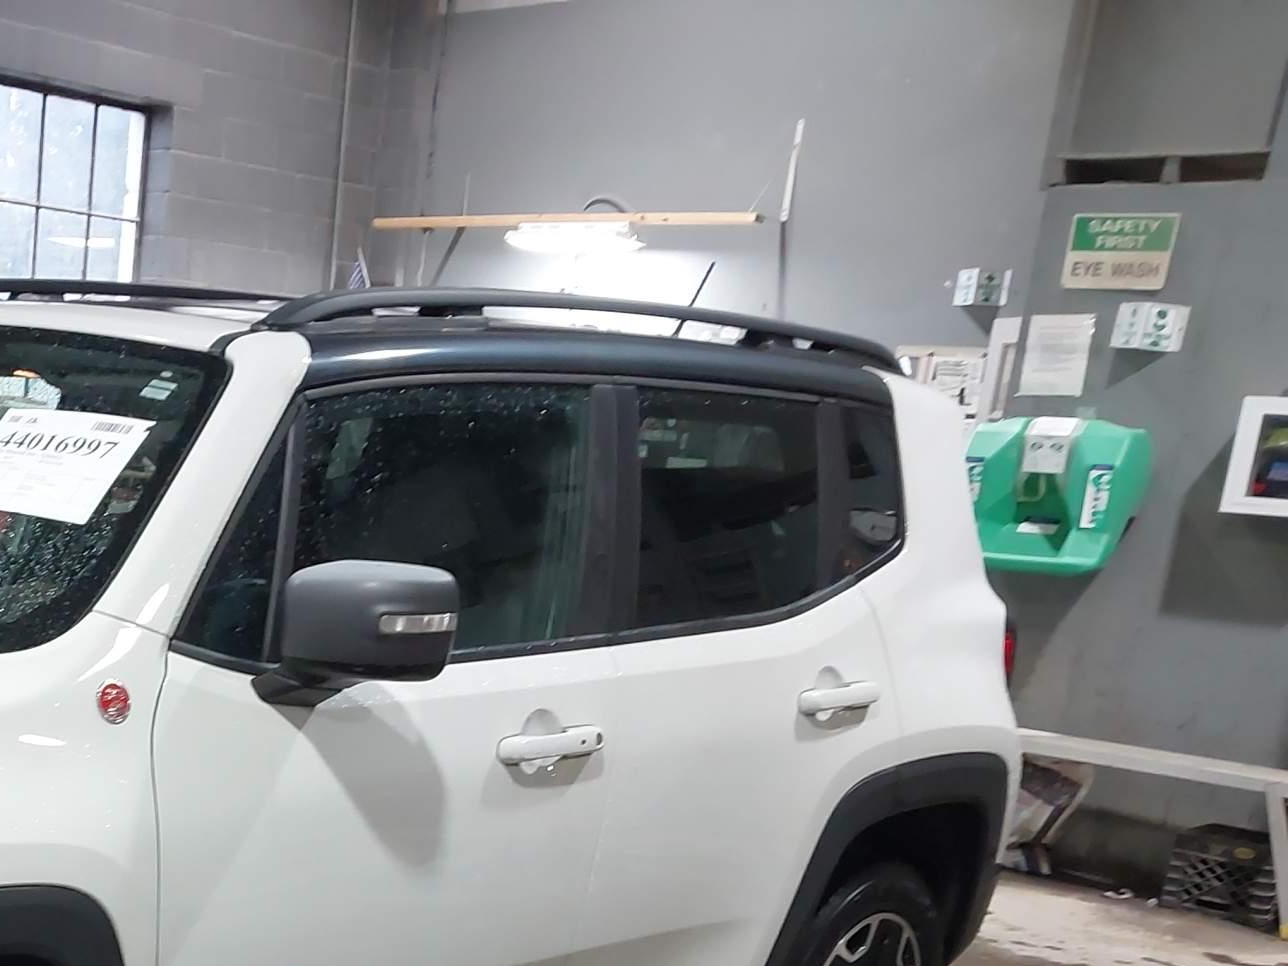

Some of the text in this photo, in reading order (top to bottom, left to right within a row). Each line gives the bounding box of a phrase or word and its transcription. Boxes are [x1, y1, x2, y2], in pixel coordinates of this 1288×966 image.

[1088, 219, 1162, 233] SAFETY
[1094, 234, 1148, 249] FIRST
[1070, 261, 1162, 279] EYE WASH
